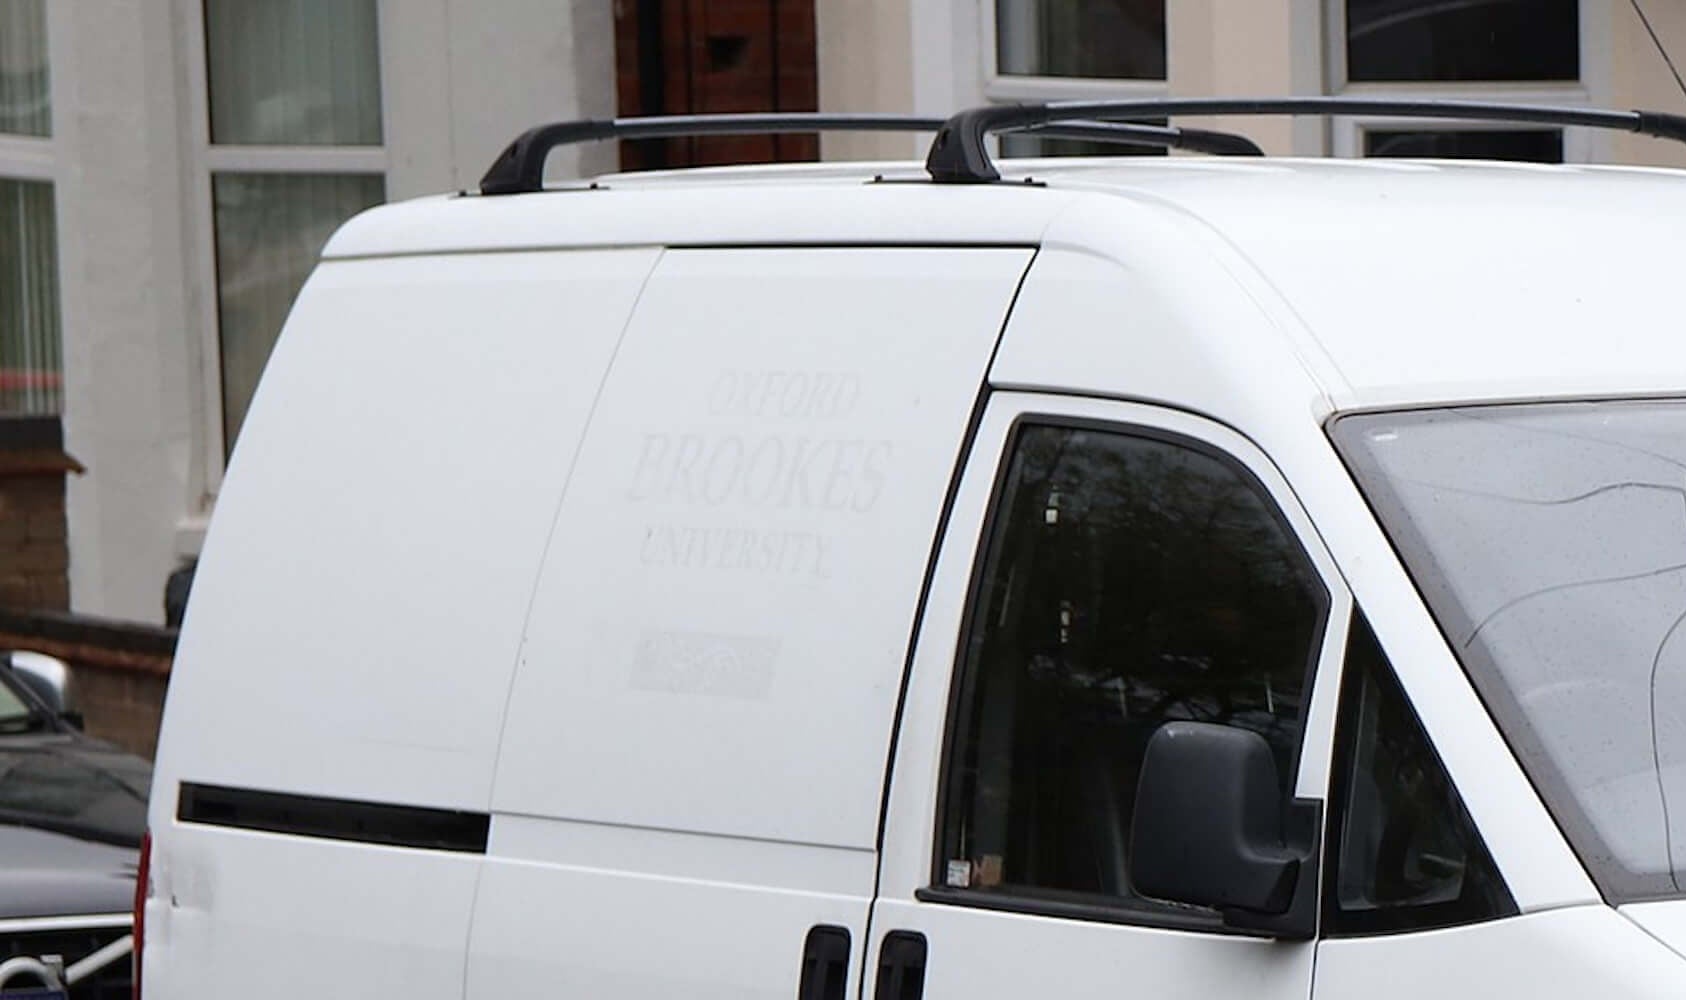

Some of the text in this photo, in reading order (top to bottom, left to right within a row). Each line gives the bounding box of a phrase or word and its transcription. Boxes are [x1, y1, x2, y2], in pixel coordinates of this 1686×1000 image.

[706, 368, 863, 419] OXFORD
[624, 431, 895, 514] BROOKES
[638, 524, 833, 580] UNIVERSITY
